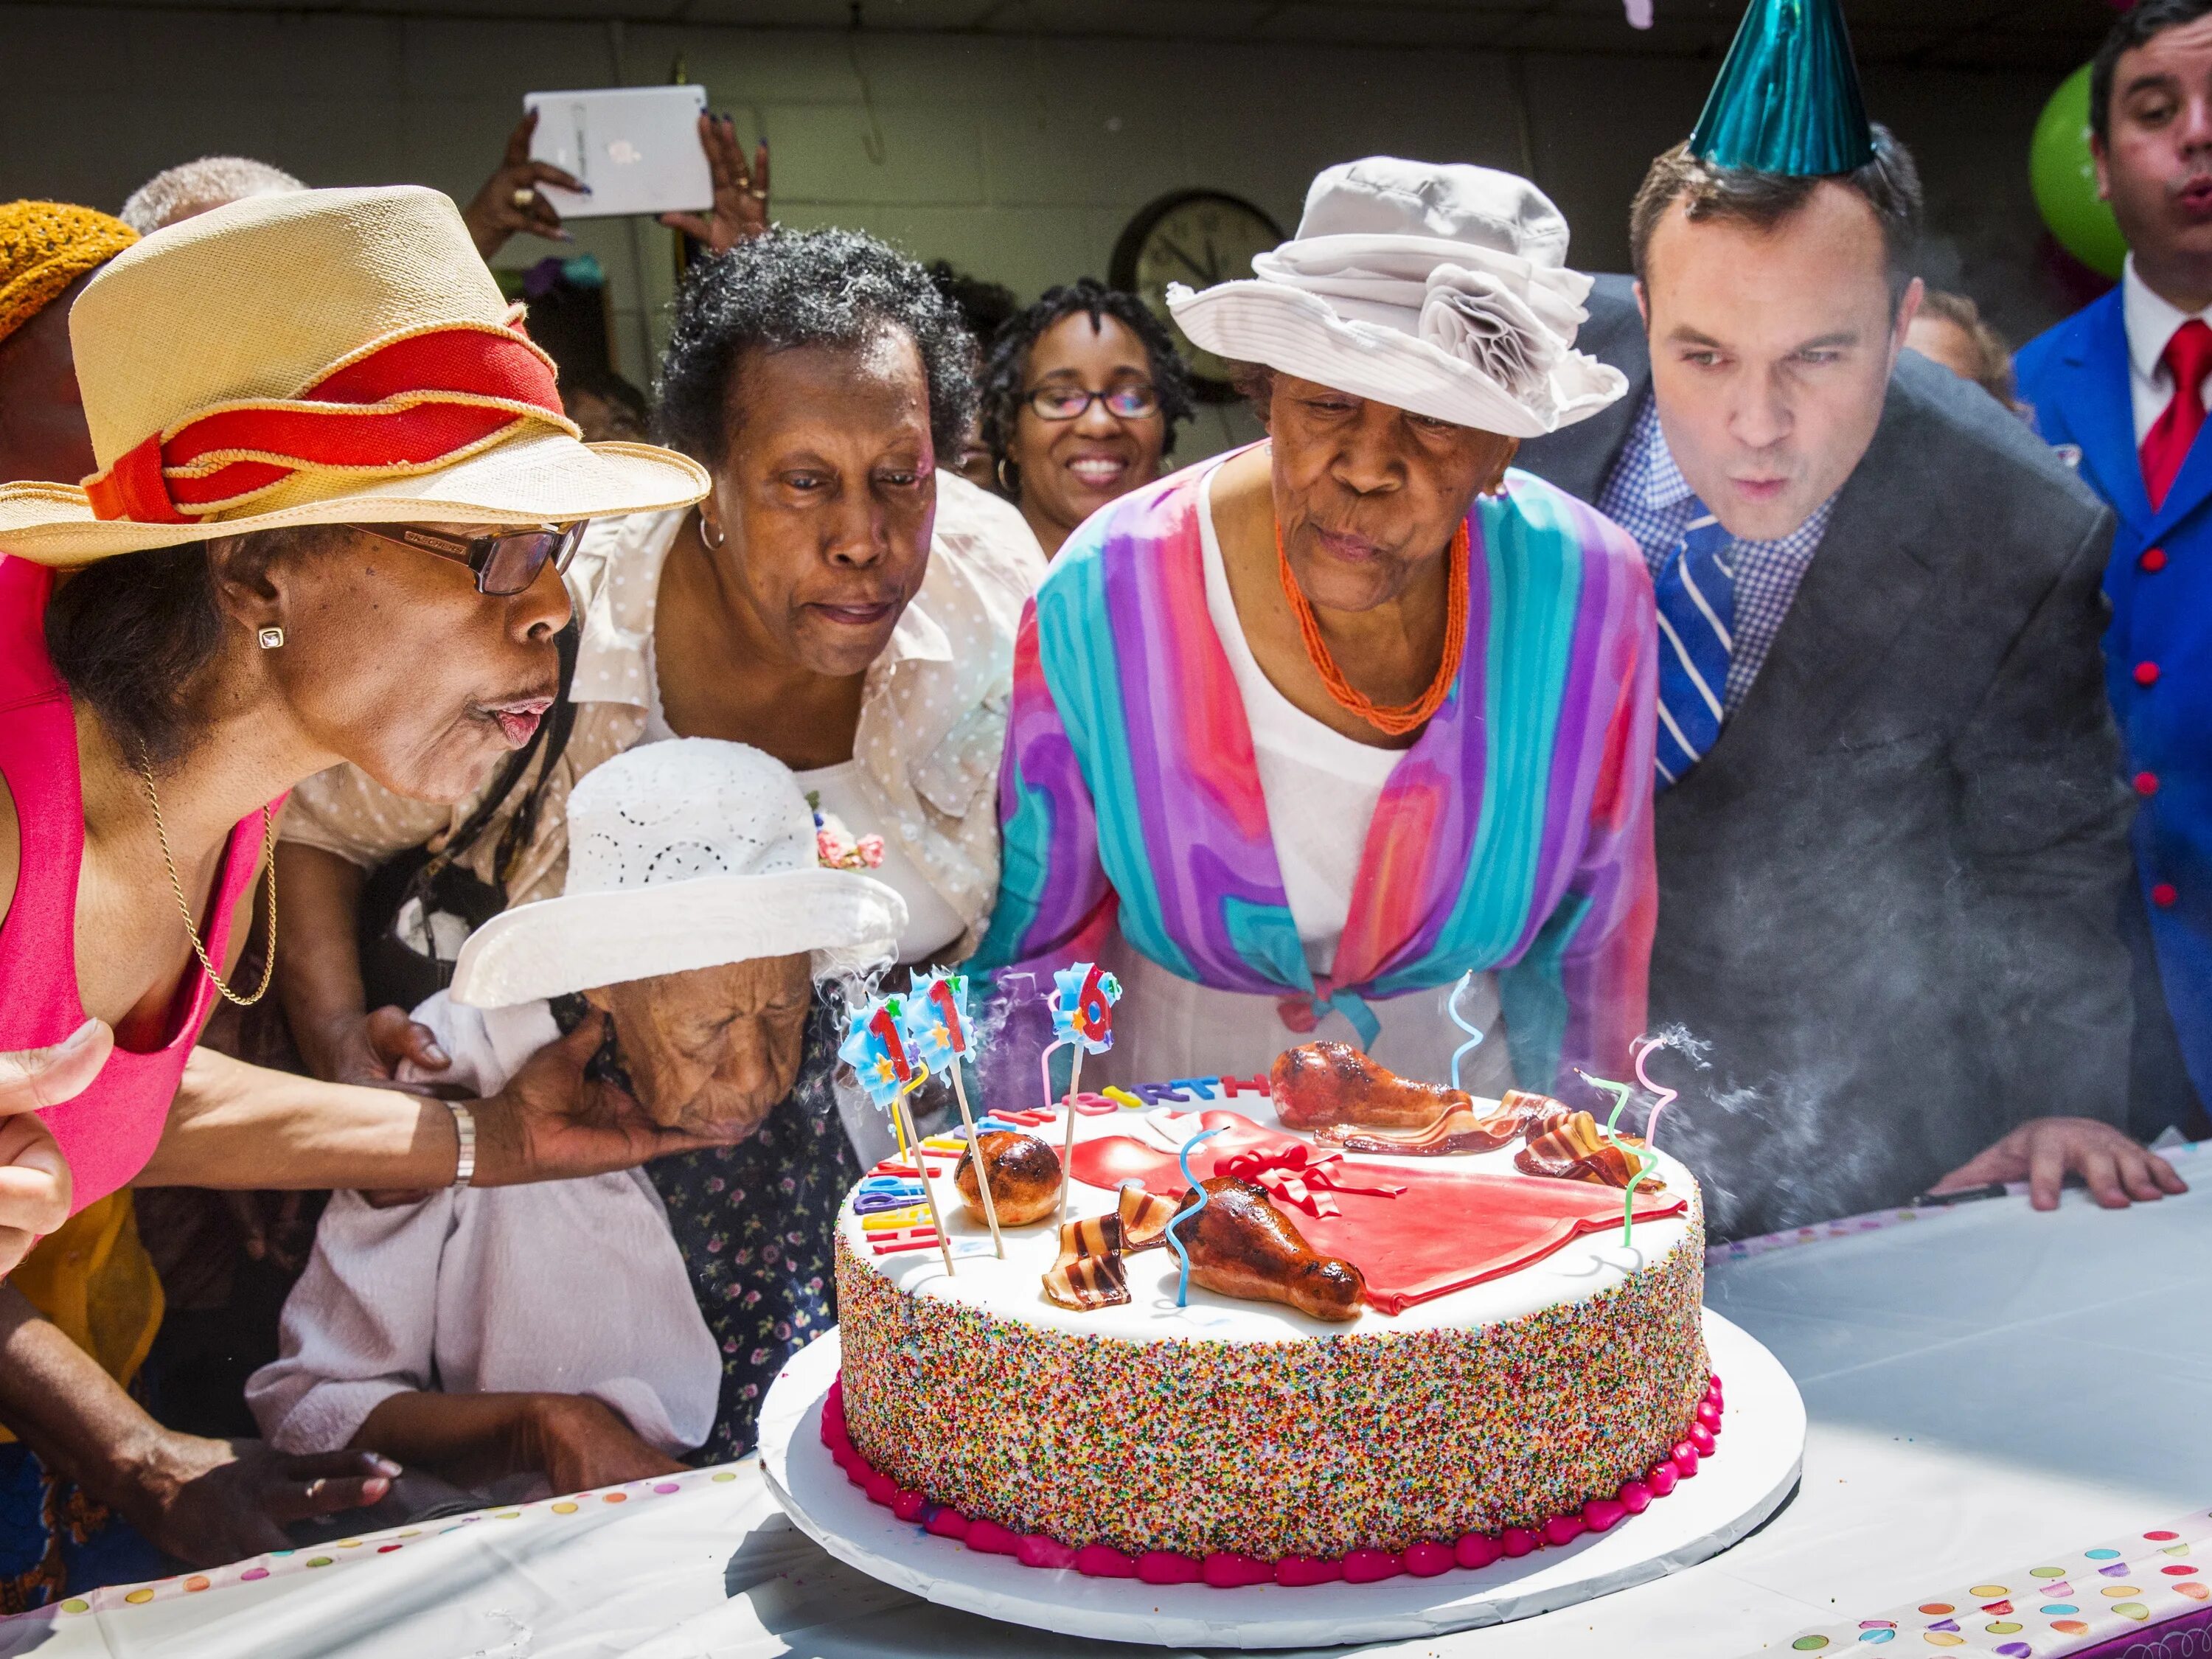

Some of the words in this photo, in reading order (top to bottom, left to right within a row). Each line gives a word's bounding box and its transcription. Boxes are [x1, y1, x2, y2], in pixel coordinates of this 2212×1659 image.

[408, 533, 465, 554] SKECHERS
[853, 1161, 951, 1254] HAPPY
[1062, 1074, 1270, 1116] BIRTH
